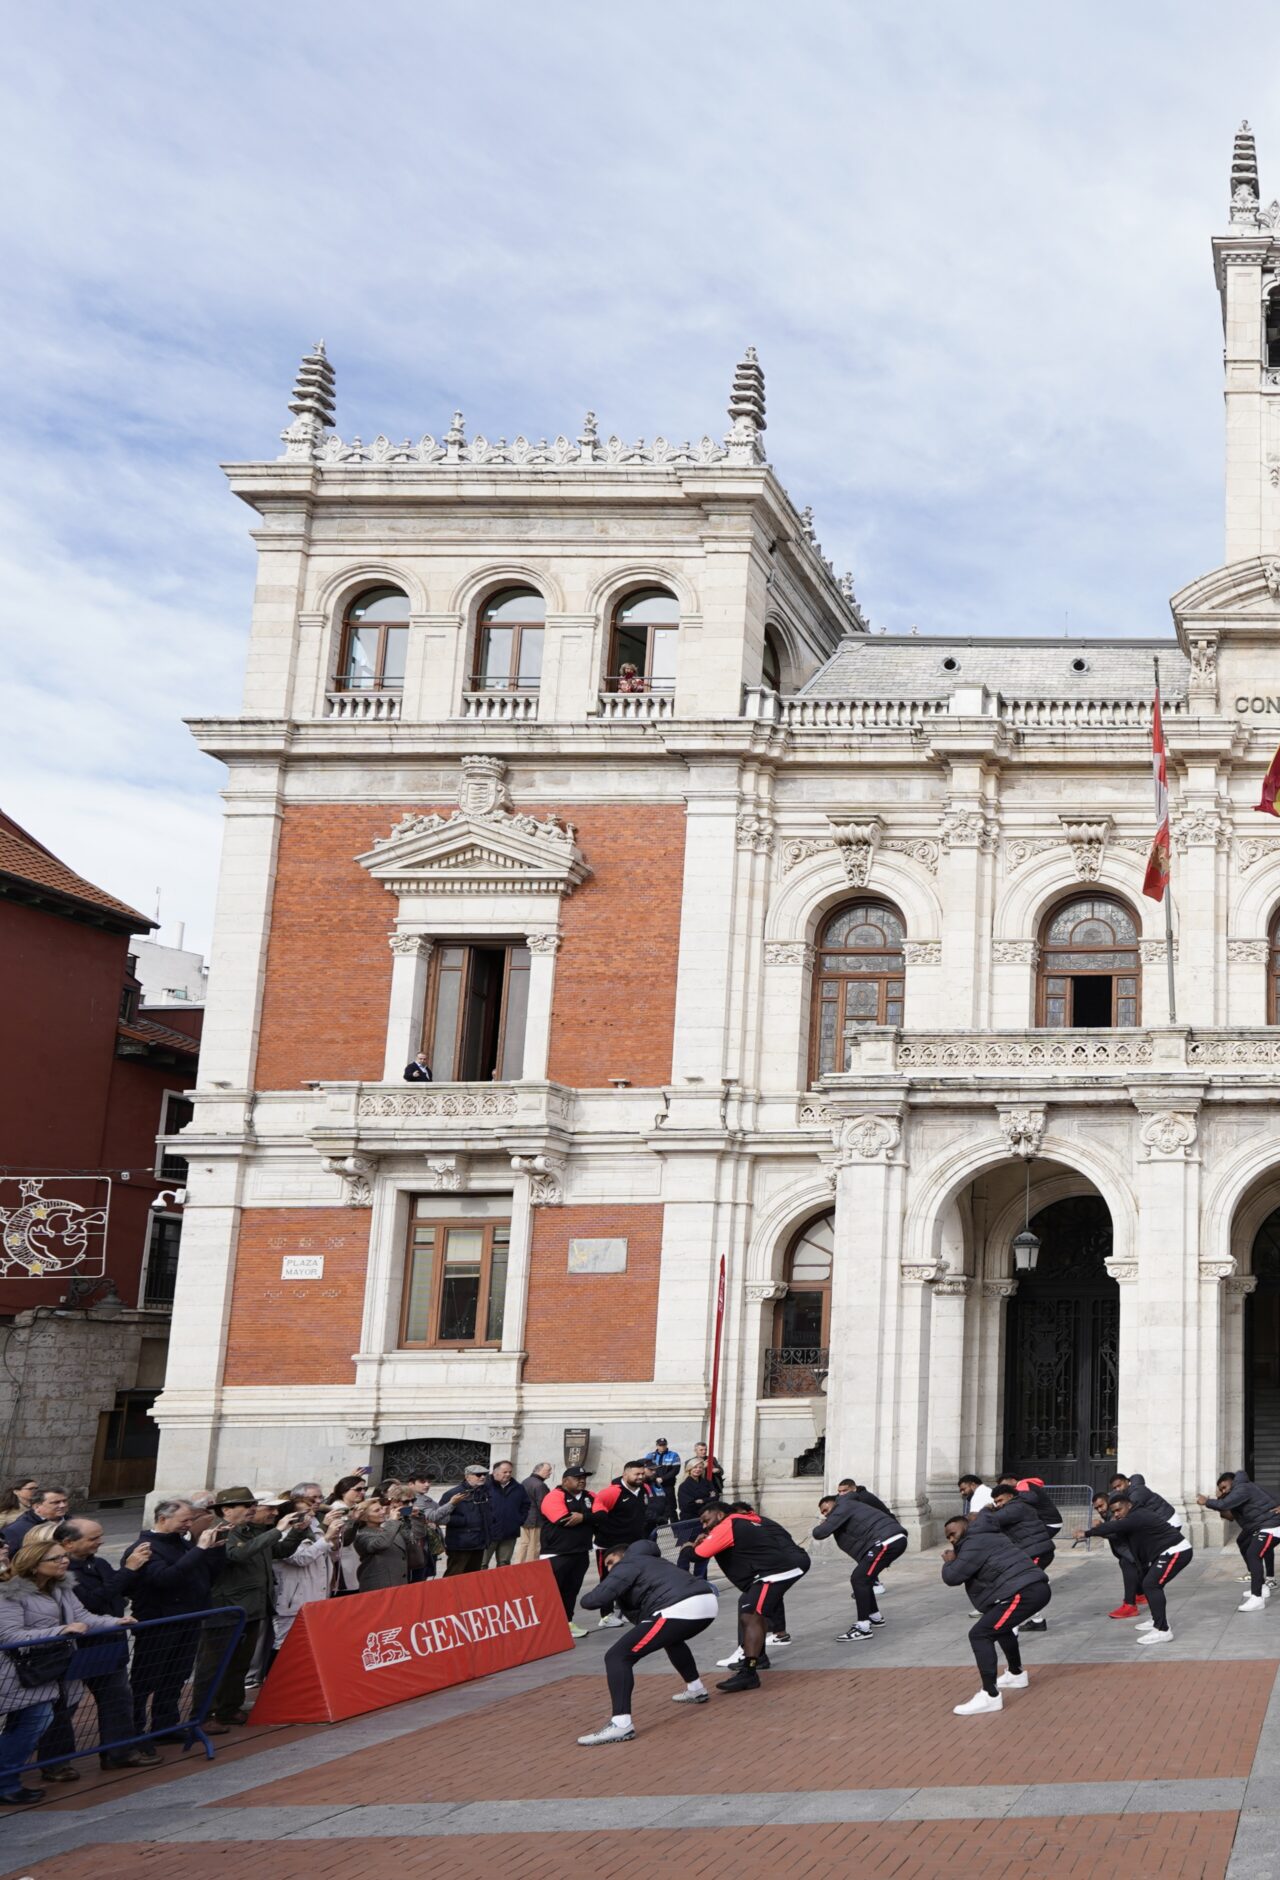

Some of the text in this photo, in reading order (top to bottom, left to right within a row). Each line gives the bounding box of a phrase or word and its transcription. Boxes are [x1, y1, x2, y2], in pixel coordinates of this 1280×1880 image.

[286, 1259, 318, 1267] PLAZA
[285, 1268, 318, 1276] MAYOR
[411, 1595, 540, 1656] GENERALI
